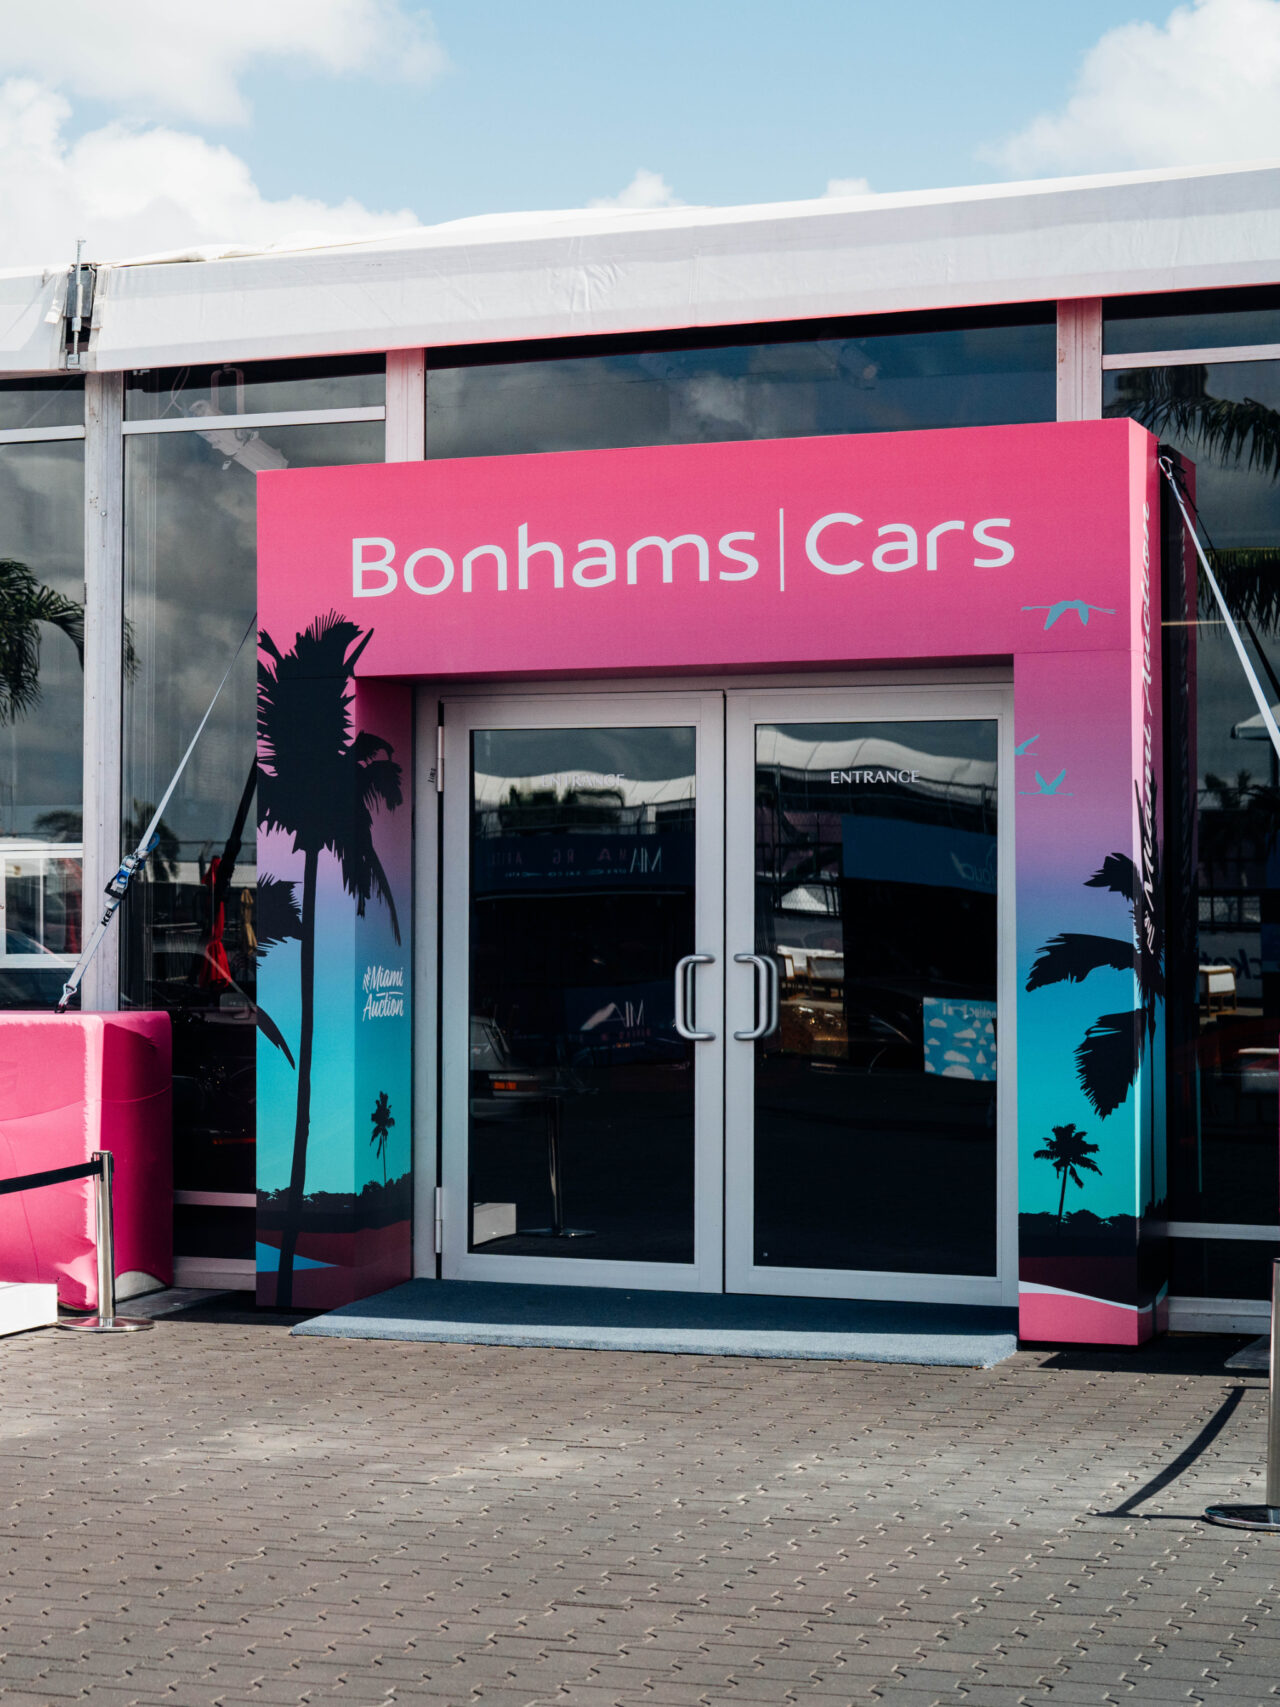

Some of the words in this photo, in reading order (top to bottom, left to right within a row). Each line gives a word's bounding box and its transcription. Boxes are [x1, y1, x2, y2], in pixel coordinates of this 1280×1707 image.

[352, 522, 759, 598] Bonhams
[804, 512, 1015, 575] Cars
[1140, 501, 1152, 716] Auction
[541, 773, 625, 788] ENTRANCE
[830, 769, 921, 785] ENTRANCE
[1143, 723, 1154, 912] Miami
[370, 964, 404, 992] Miami
[362, 992, 404, 1022] Auction
